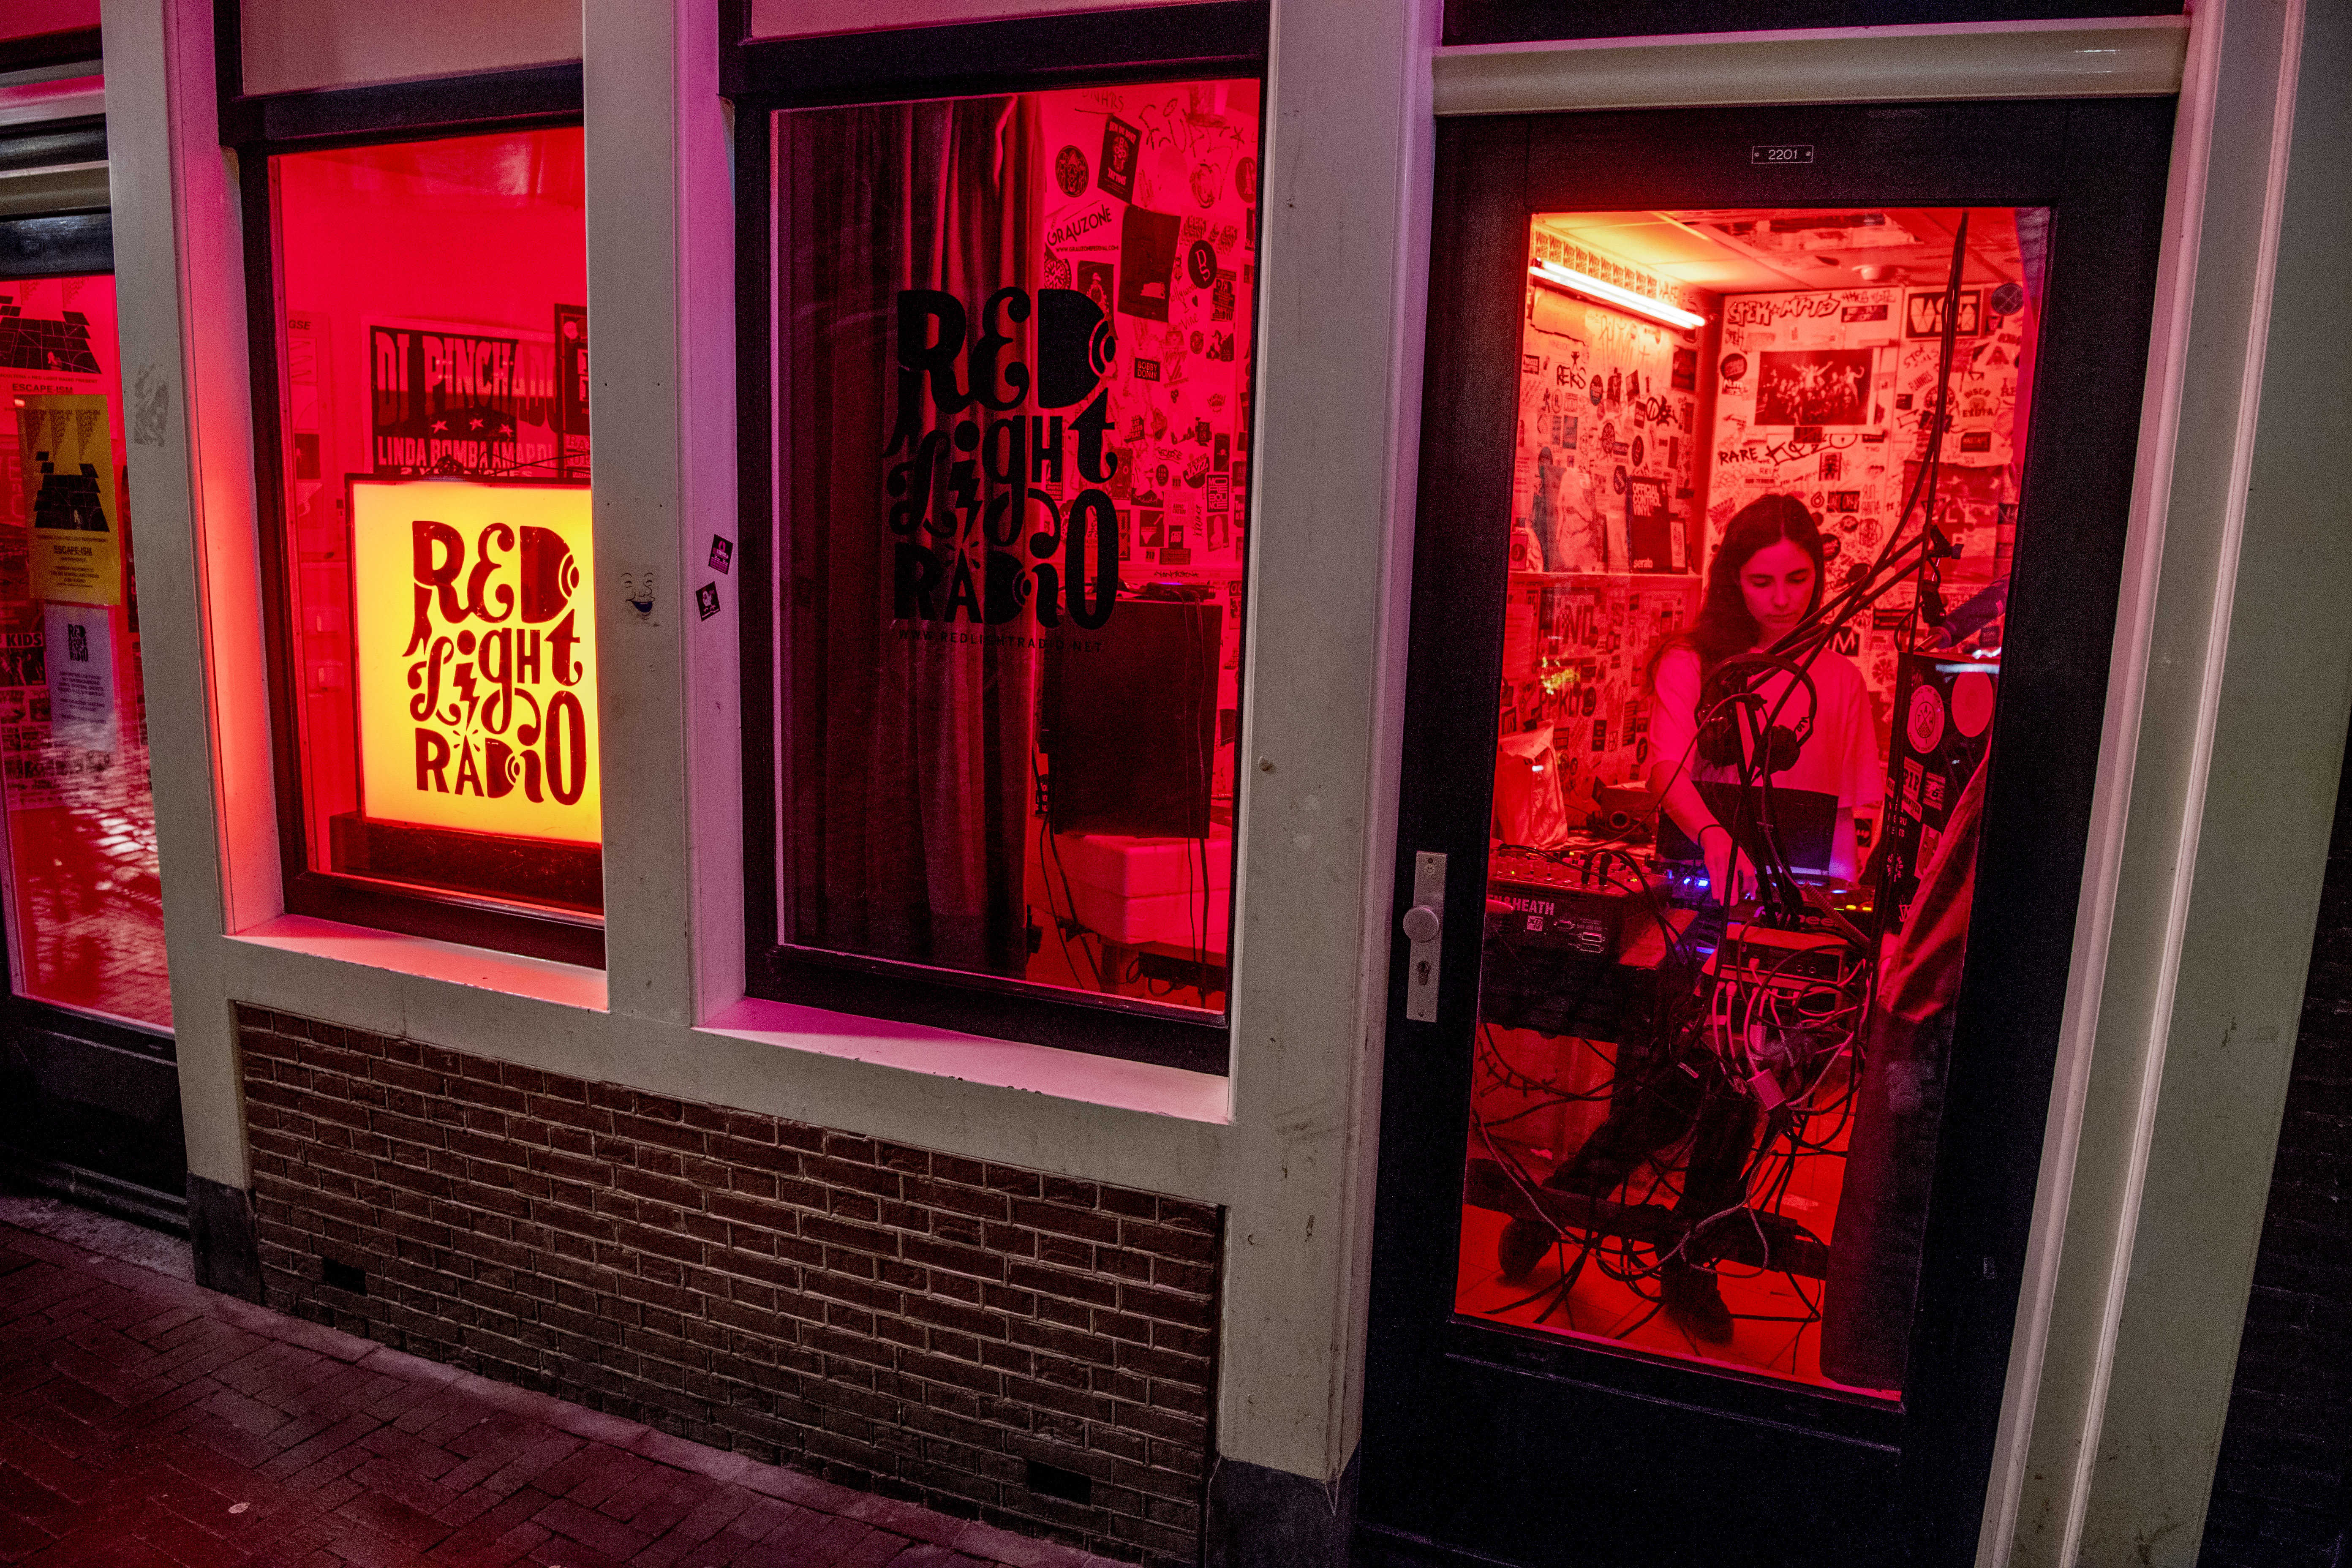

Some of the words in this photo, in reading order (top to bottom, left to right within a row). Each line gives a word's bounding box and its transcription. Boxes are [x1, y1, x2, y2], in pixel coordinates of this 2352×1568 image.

[1768, 149, 1798, 161] 2201
[1047, 204, 1112, 246] GRAUZONE
[882, 286, 1116, 458] RED
[1138, 361, 1158, 372] BOBBY
[12, 383, 74, 394] ESCAPE-ISM
[378, 436, 426, 466] LINDA
[1718, 447, 1759, 465] RARE
[1185, 459, 1209, 481] JAZZ
[1632, 482, 1658, 495] OFFICIAL
[1632, 493, 1662, 507] CONTROL
[1633, 505, 1652, 517] VINYL
[1633, 557, 1654, 569] serato
[403, 520, 580, 656] RED
[6, 634, 42, 647] KIDS
